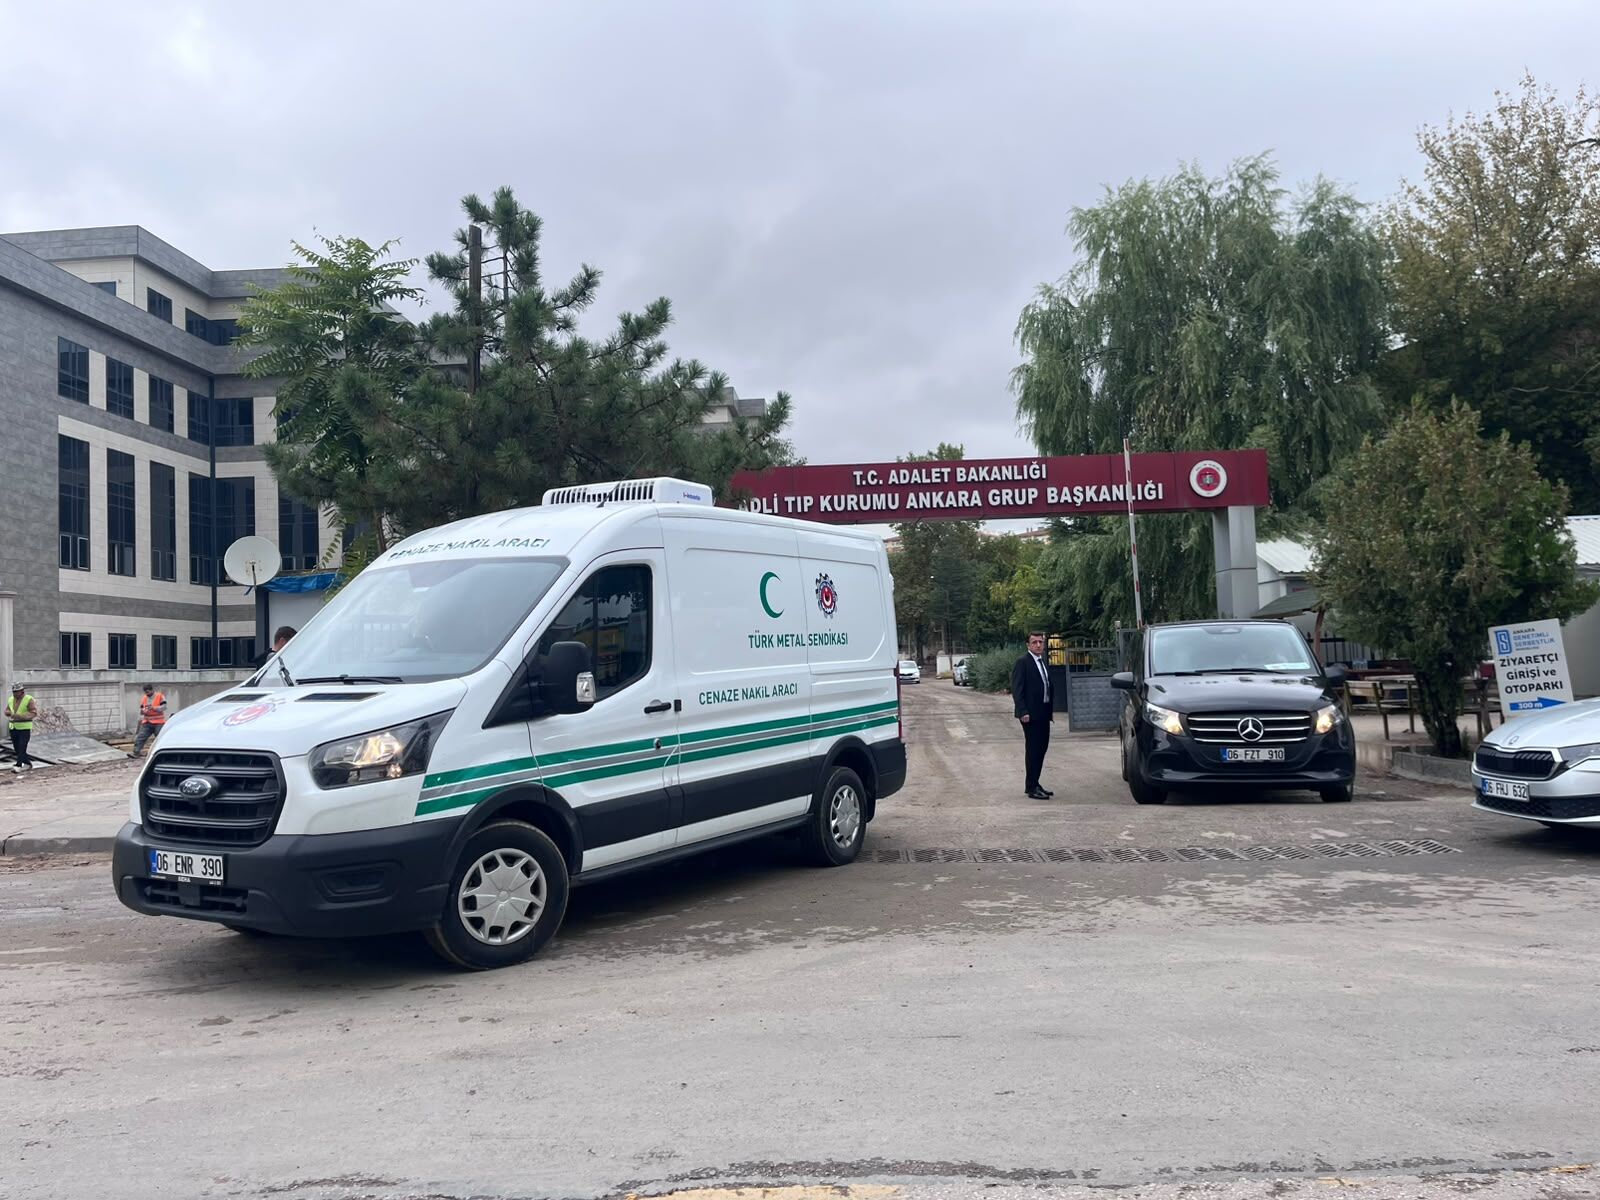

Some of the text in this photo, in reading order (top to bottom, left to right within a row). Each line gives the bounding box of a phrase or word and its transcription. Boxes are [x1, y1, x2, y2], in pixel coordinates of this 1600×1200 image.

[853, 461, 1047, 486] T.C. ADALET BAKANLIĞI
[784, 495, 814, 513] TIP
[820, 493, 899, 512] KURUMU
[906, 490, 982, 509] ANKARA
[988, 488, 1038, 506] GRUP
[748, 628, 848, 649] TÜRK METAL SENDİKASI
[1506, 666, 1540, 680] GİRİŞİ
[699, 688, 739, 705] CENAZE
[772, 683, 798, 696] ARACI
[1504, 681, 1563, 694] OTOPARKI
[1228, 750, 1284, 760] 06 FZT 910
[1512, 784, 1528, 799] 632
[157, 853, 222, 877] 06 ENR 390
